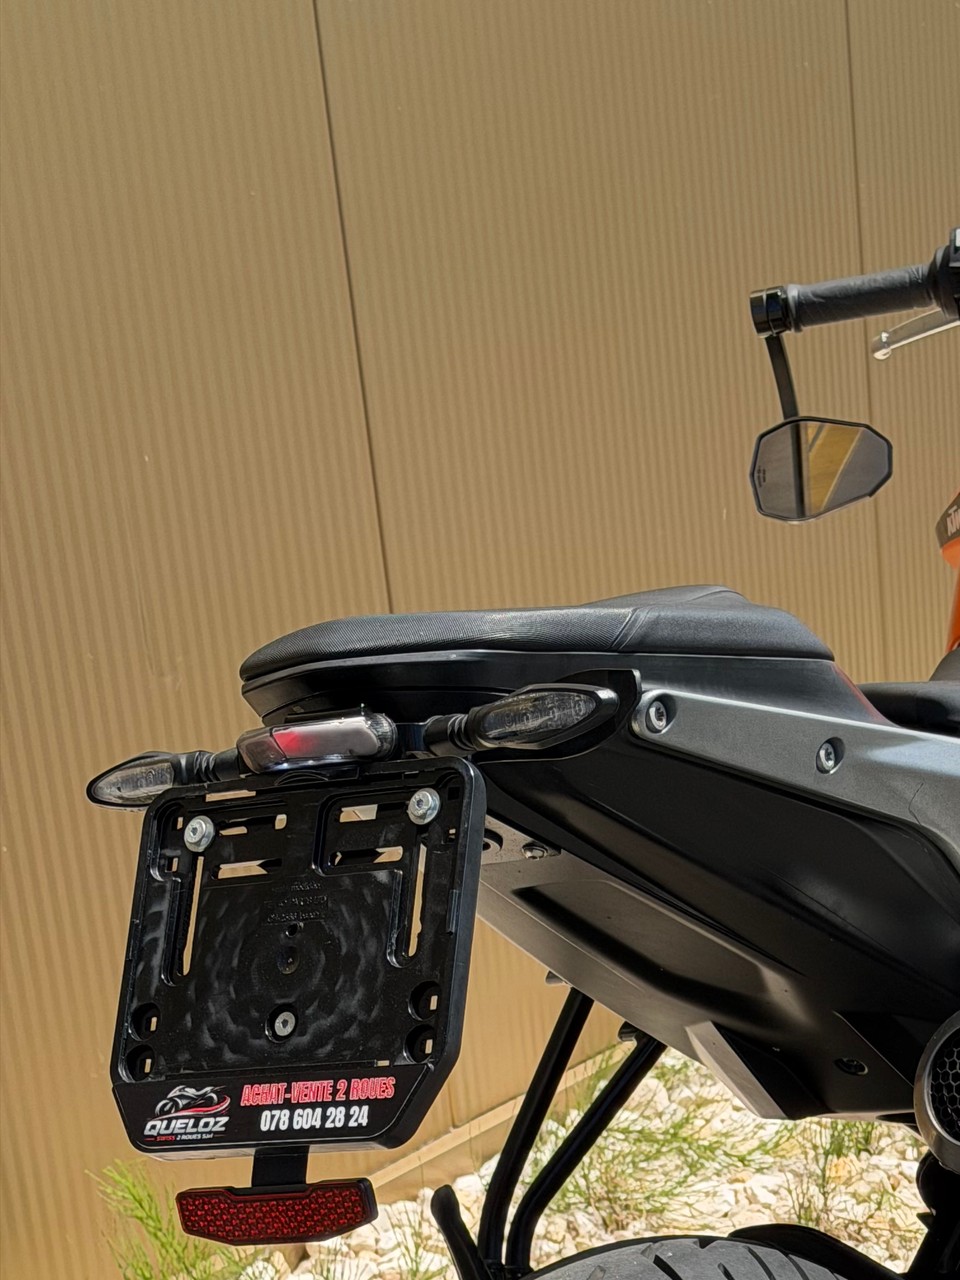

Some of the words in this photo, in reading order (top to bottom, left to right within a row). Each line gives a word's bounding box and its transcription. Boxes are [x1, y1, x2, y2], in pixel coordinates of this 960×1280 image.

[240, 1082, 332, 1106] ACHAT-VENTE
[336, 1079, 348, 1101] 2
[349, 1077, 396, 1100] ROUES
[143, 1116, 230, 1136] QUELOZ
[260, 1110, 289, 1132] 078
[293, 1107, 321, 1129] 604
[325, 1106, 345, 1128] 28
[348, 1105, 369, 1127] 24
